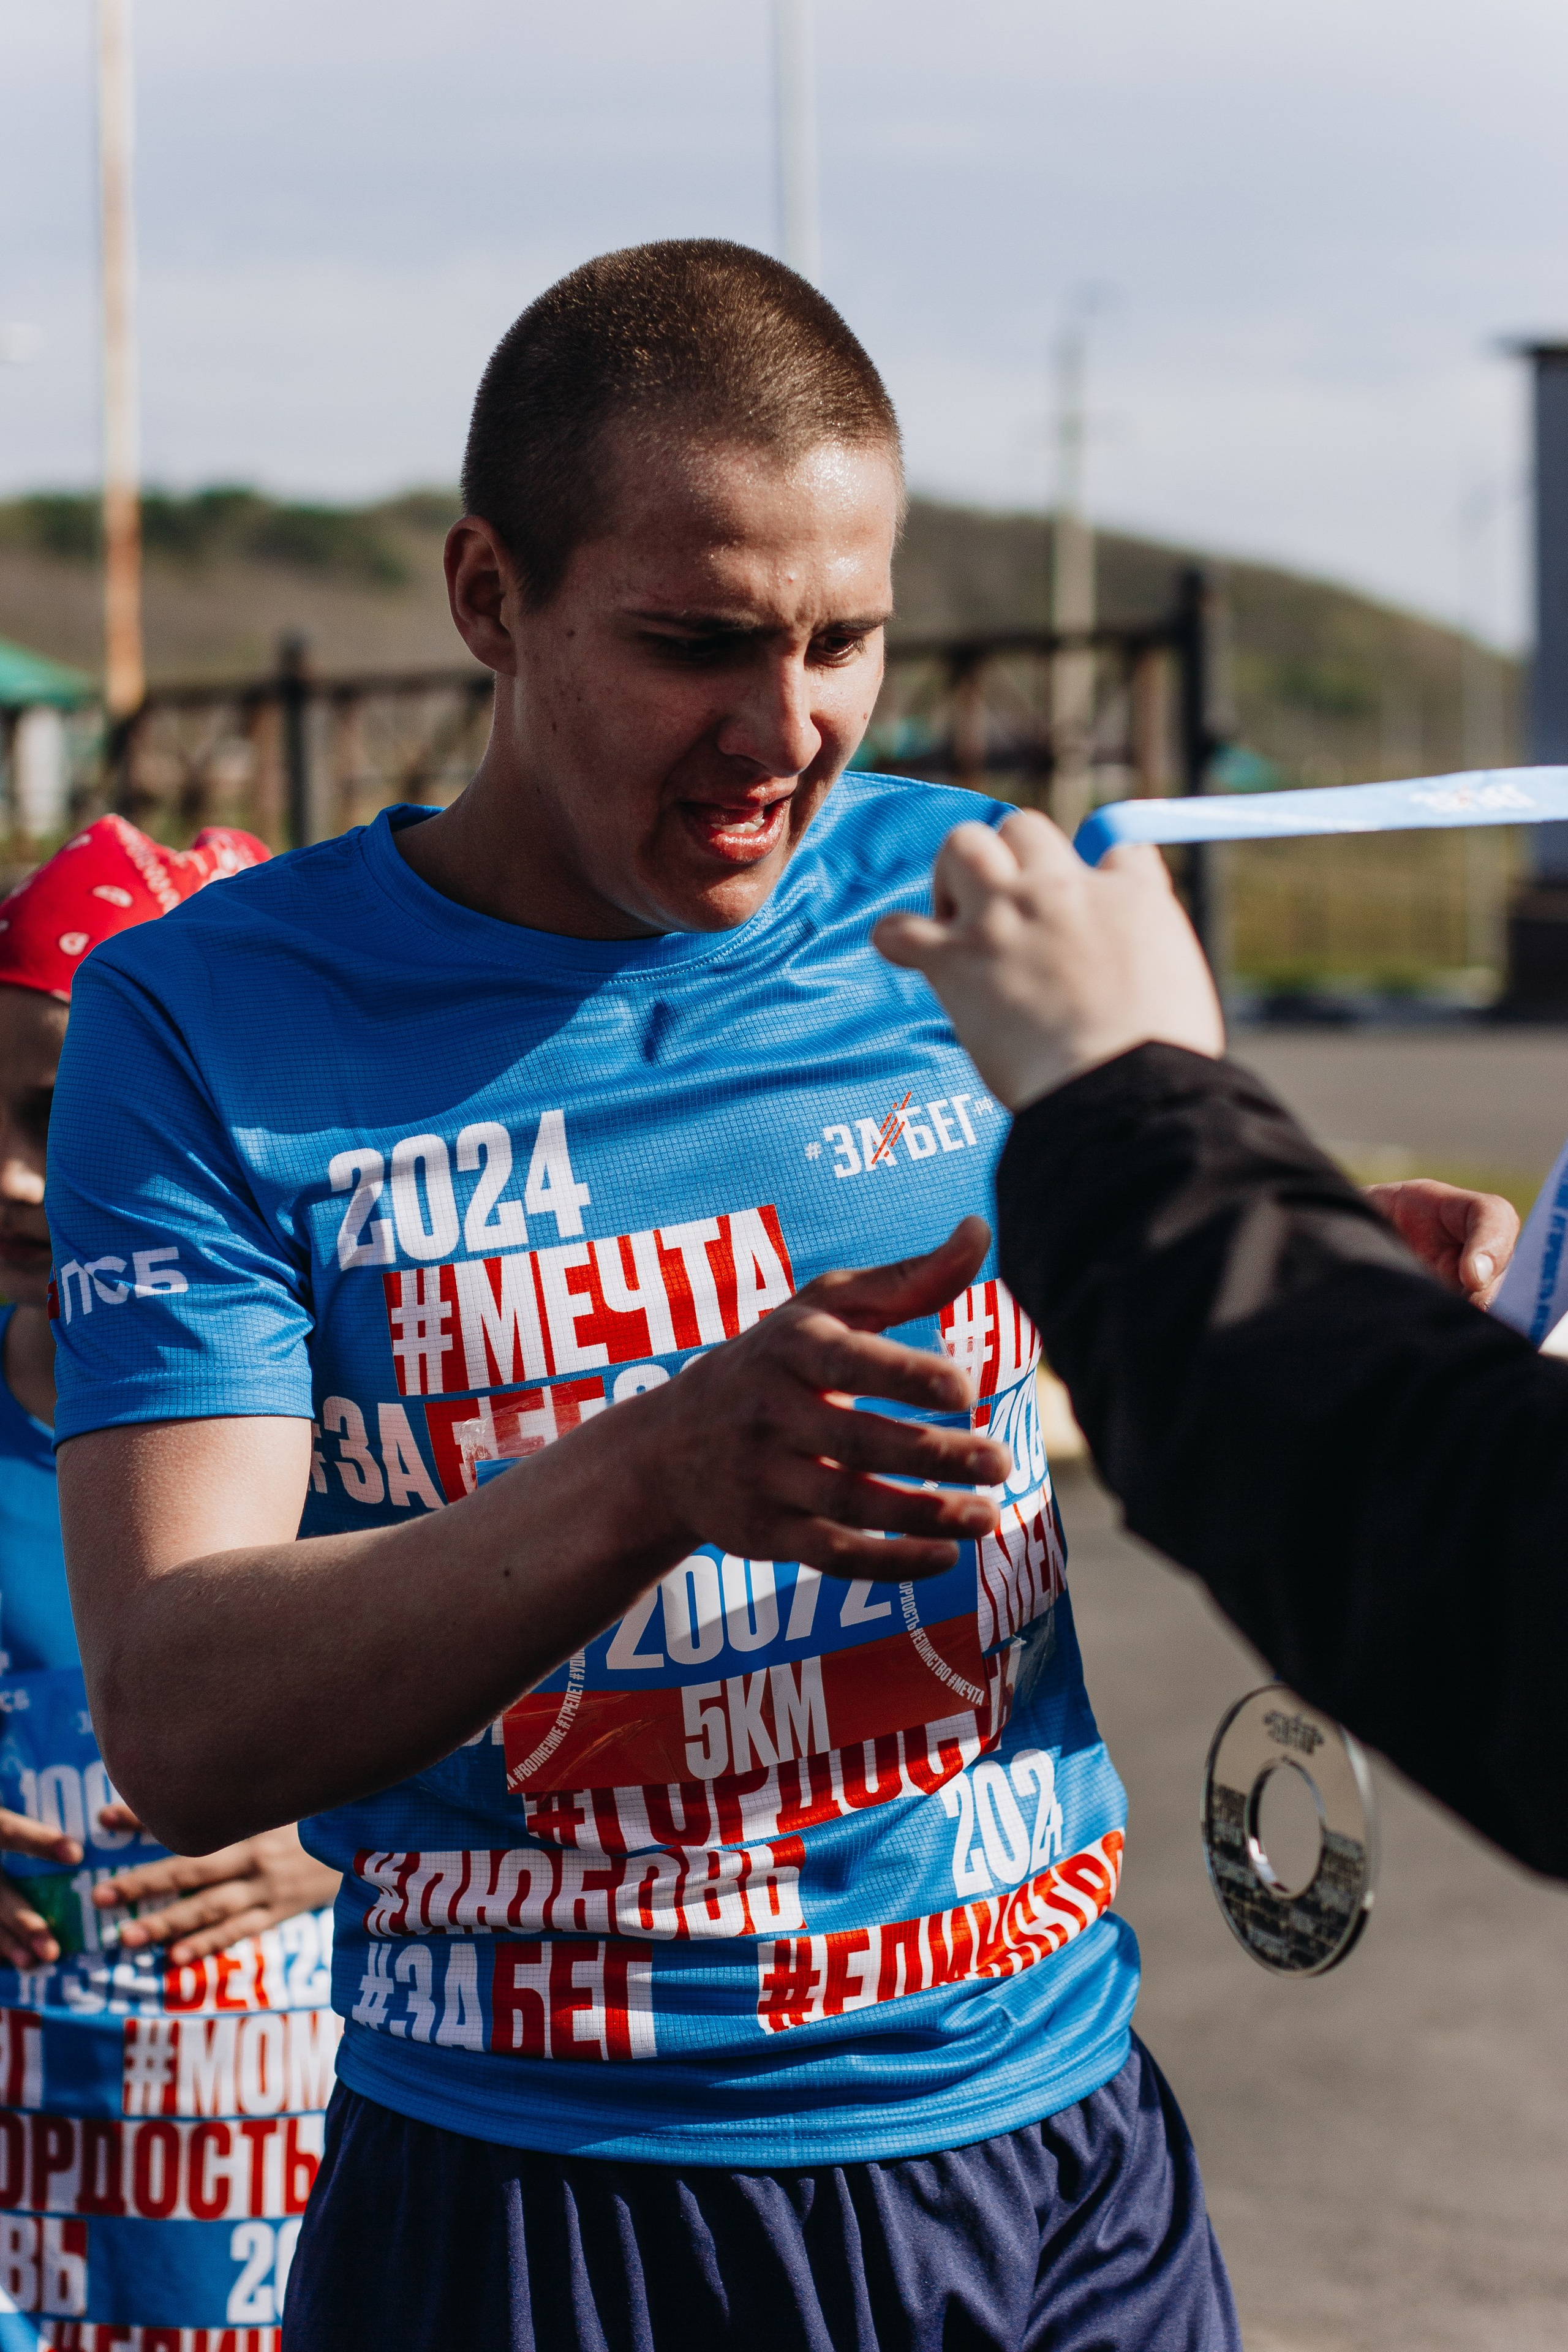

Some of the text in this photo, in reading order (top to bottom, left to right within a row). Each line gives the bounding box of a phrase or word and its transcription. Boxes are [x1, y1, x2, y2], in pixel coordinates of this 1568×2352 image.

[329, 1109, 591, 1271] 2024
[61, 1246, 188, 1325] ПСБ
[391, 1206, 794, 1395] #МЕЧТА
[569, 1647, 585, 1680] #УДИ
[910, 1627, 952, 1681] #ЕДИНСТВО
[946, 1673, 985, 1706] #МЕЧТА
[556, 1681, 584, 1730] #ТРЕПЕТ
[513, 1725, 567, 1782] #ВОЛНЕНИЕ
[361, 1844, 801, 1940] #ЛЮБОВЬ
